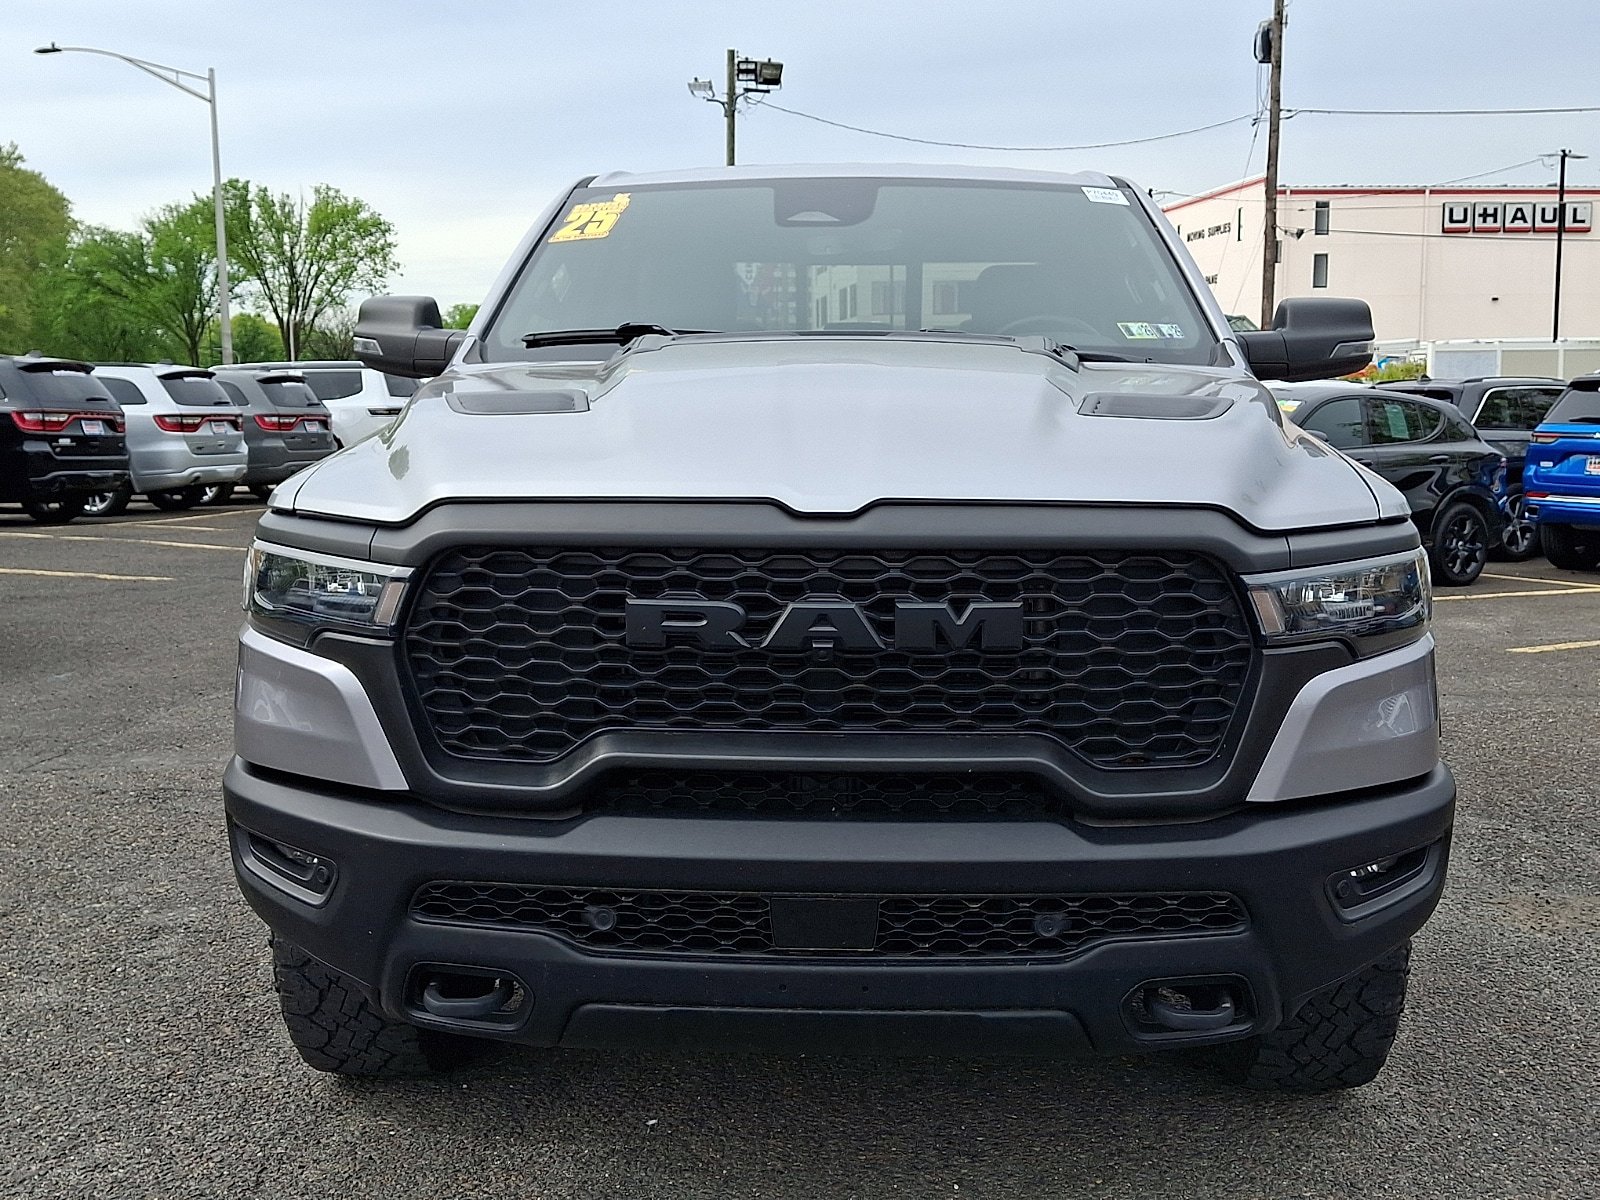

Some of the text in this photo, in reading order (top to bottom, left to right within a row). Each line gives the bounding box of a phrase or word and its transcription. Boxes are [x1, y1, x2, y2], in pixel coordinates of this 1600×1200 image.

[553, 210, 620, 238] 25
[1187, 222, 1231, 242] MOVING SUPPLIES
[626, 599, 1023, 650] RAM
